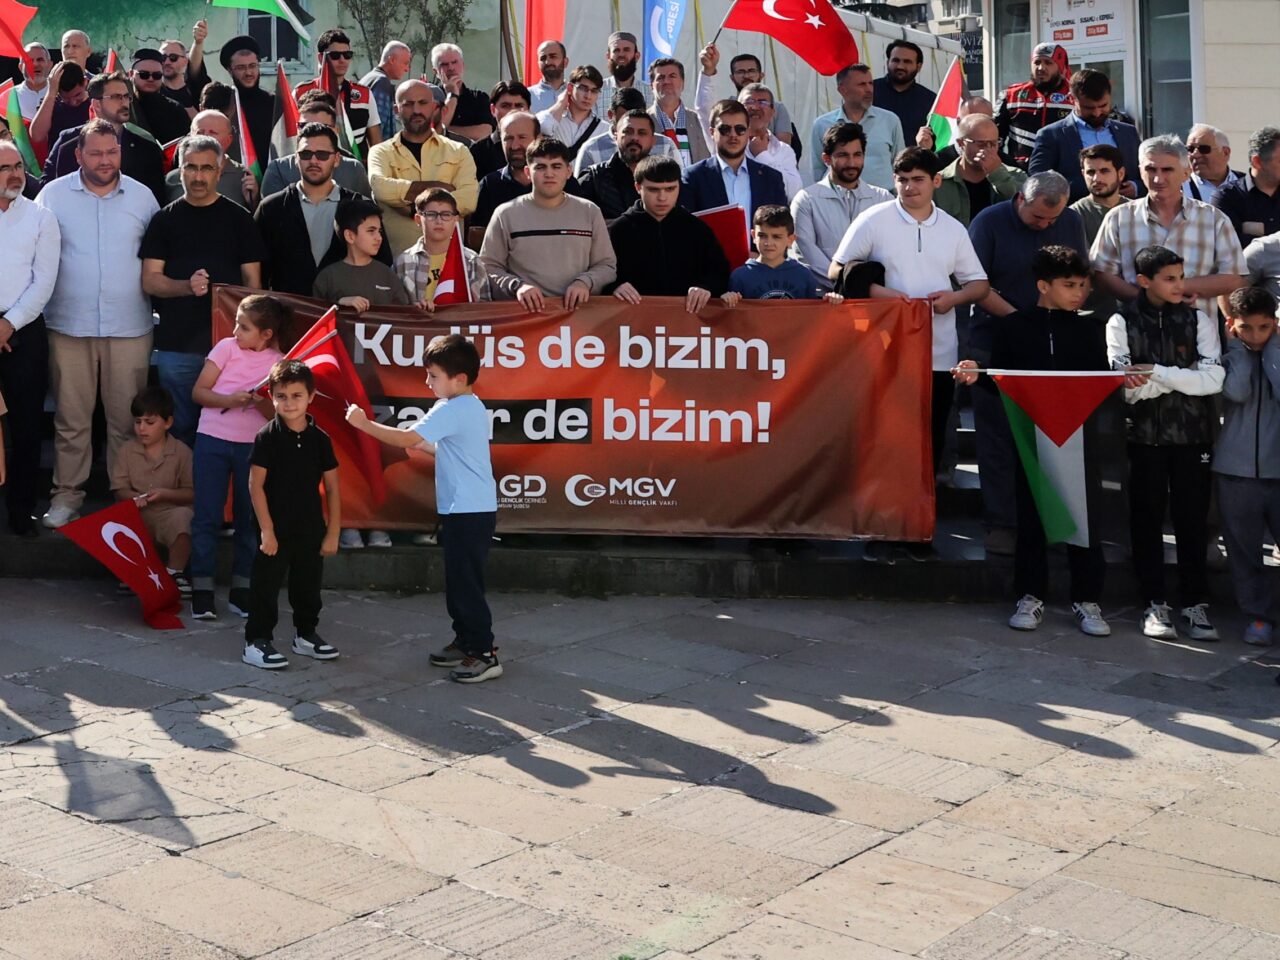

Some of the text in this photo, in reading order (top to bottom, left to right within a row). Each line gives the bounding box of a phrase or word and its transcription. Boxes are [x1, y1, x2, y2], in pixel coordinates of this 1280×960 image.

[354, 323, 786, 380] Kuüs de bizim,
[523, 399, 589, 440] de
[603, 398, 770, 443] bizim!
[499, 474, 677, 498] GD MGV
[628, 499, 657, 507] GENÇLİK
